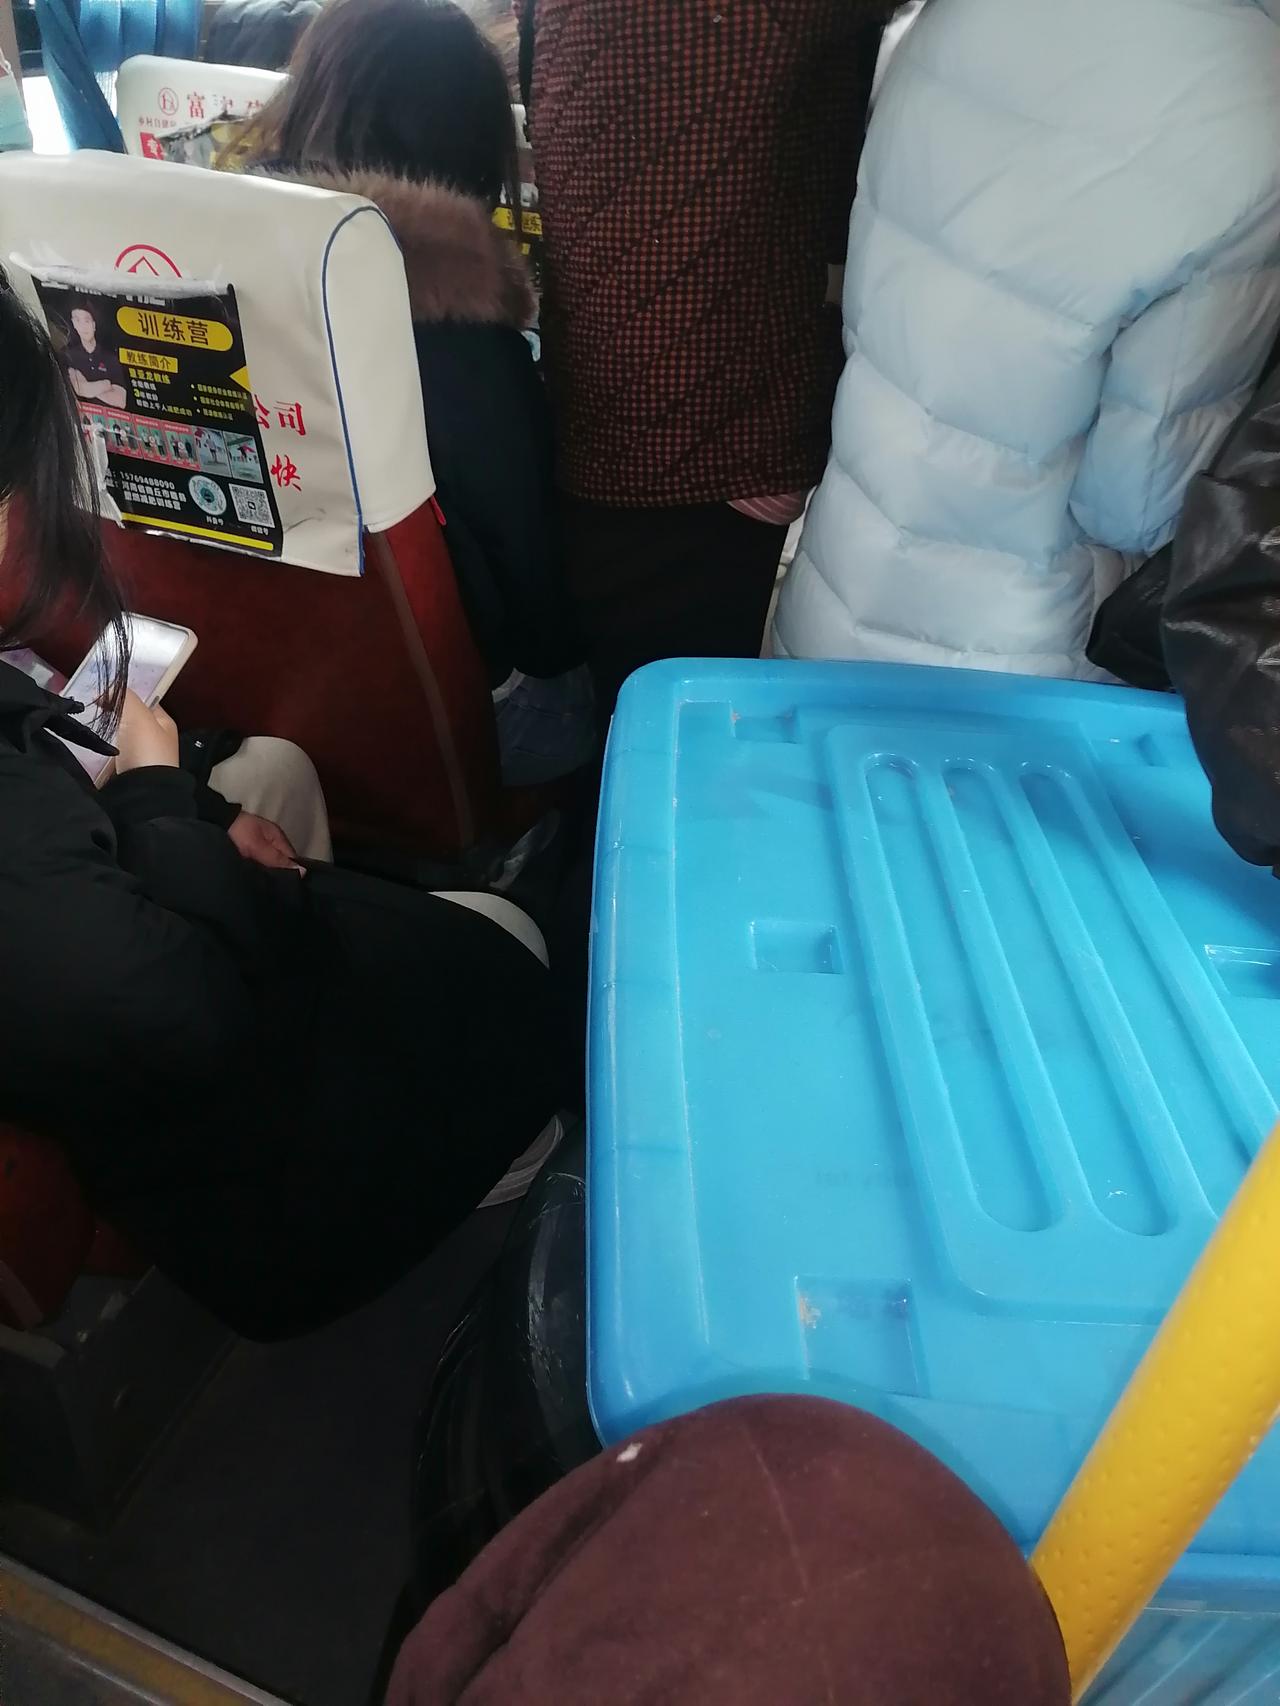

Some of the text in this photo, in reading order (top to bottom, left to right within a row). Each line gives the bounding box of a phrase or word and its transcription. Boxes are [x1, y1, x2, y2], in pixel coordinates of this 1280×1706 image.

[138, 311, 209, 346] 训练营
[126, 350, 171, 371] 教练简介
